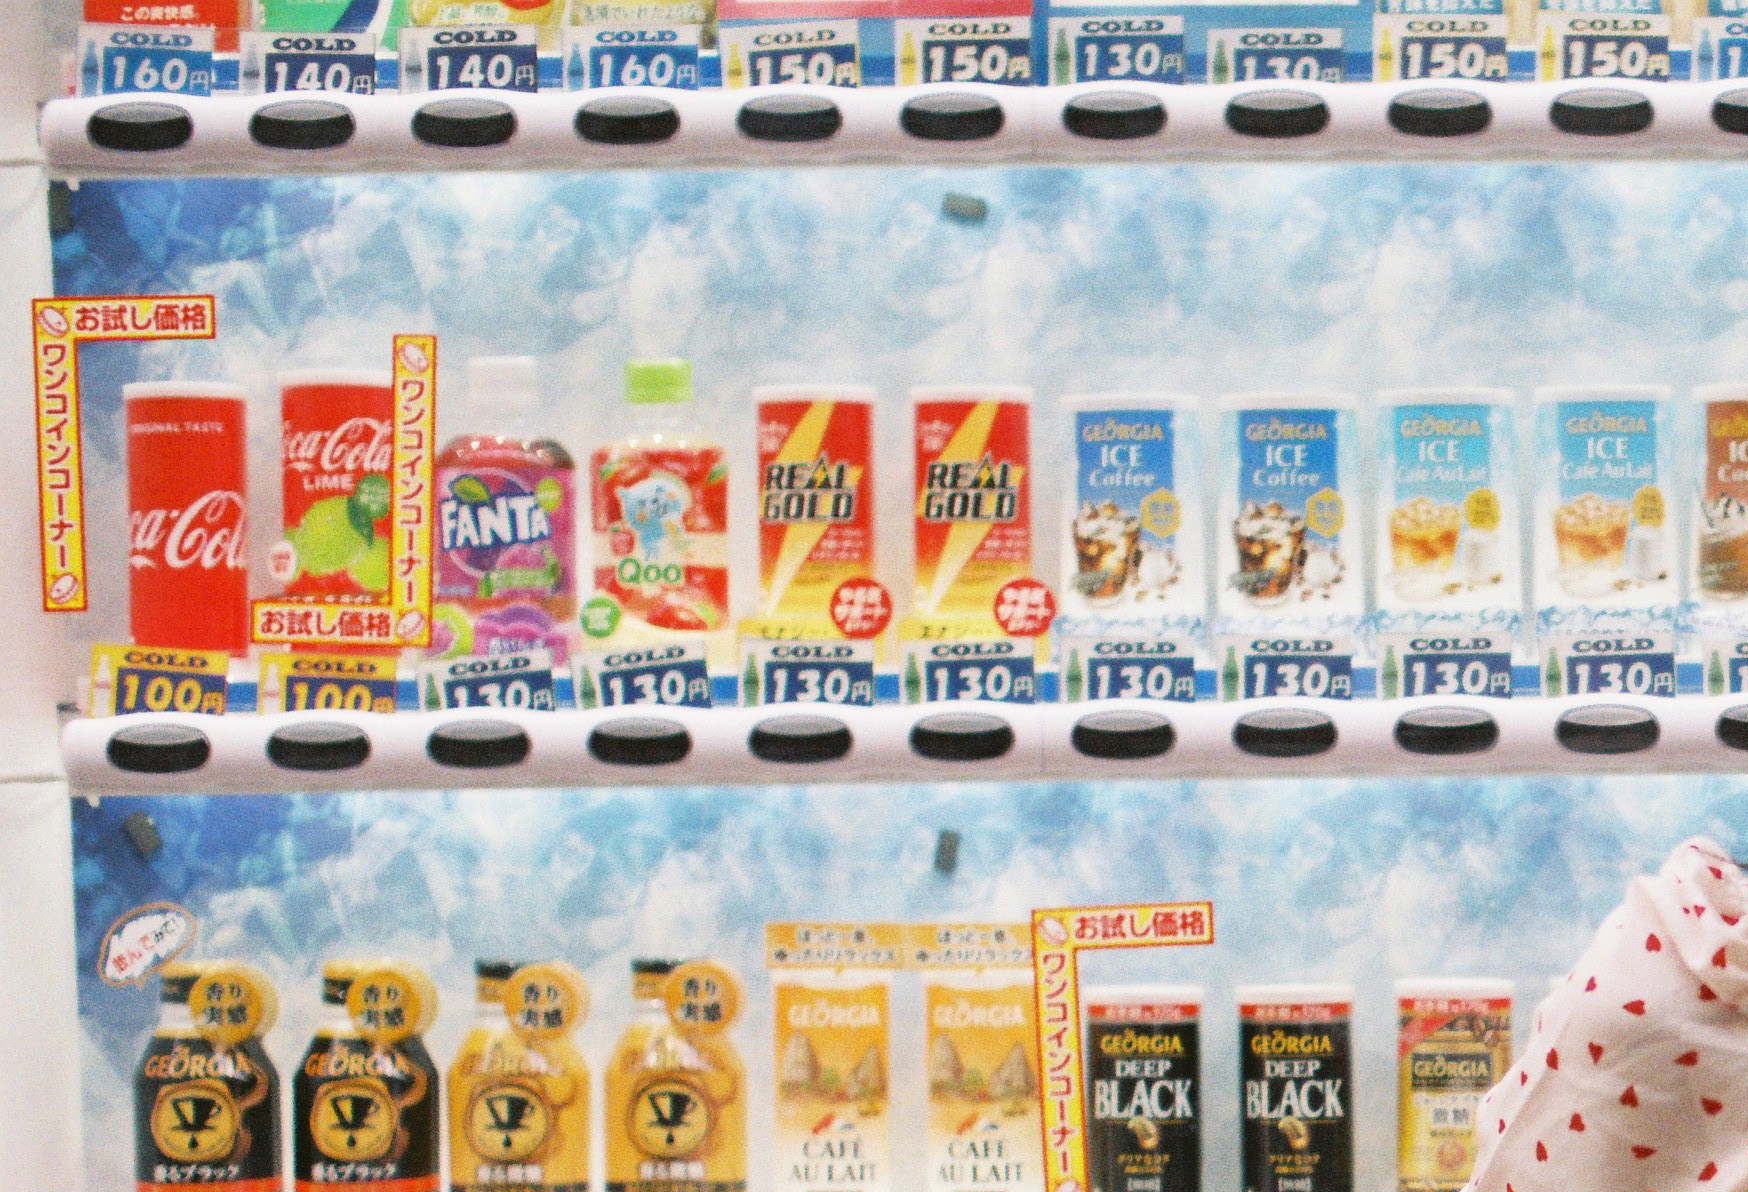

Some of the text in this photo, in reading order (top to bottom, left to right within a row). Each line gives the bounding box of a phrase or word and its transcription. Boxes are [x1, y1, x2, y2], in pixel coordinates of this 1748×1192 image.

[434, 31, 517, 44] COLD
[595, 30, 677, 43] COLD
[754, 28, 836, 46] COLD
[928, 22, 1010, 36] COLD
[1081, 20, 1164, 33] COLD
[1406, 19, 1488, 33] COLD
[1568, 19, 1651, 32] COLD
[110, 32, 192, 47] COLD
[272, 37, 356, 51] COLD
[1241, 33, 1323, 46] COLD
[437, 55, 534, 88] 140円
[599, 54, 696, 86] 160円
[756, 52, 856, 86] 150円
[930, 45, 1030, 81] 150円
[1084, 43, 1181, 77] 130円
[1243, 57, 1339, 82] 130円
[1407, 43, 1508, 78] 150円
[1569, 41, 1668, 77] 150円
[113, 57, 209, 92] 160円
[276, 62, 371, 94] 140円
[74, 304, 206, 332] お試し価格
[42, 343, 74, 568] ワンコインコーナー
[1100, 444, 1143, 469] ICE
[1265, 443, 1308, 468] ICE
[1418, 440, 1461, 463] ICE
[1587, 437, 1630, 461] ICE
[303, 474, 355, 491] LIME
[764, 456, 851, 490] REAL
[925, 456, 1012, 490] REAL
[1088, 468, 1156, 489] Coffee
[1252, 467, 1320, 488] Coffee
[400, 379, 426, 604] ワンコインコーナー
[763, 490, 855, 520] GOLD
[924, 490, 1016, 520] GOLD
[441, 496, 550, 550] FANTA
[617, 558, 682, 584] Qoo
[260, 609, 391, 639] お試し価格
[603, 646, 685, 666] COLD
[771, 645, 854, 658] COLD
[931, 642, 1014, 657] COLD
[1094, 641, 1176, 655] COLD
[1251, 639, 1333, 653] COLD
[1410, 637, 1492, 651] COLD
[1572, 637, 1655, 653] COLD
[124, 652, 208, 668] COLD
[293, 661, 377, 675] COLD
[448, 656, 530, 676] COLD
[610, 669, 708, 703] 130円
[774, 668, 872, 703] 130円
[935, 666, 1034, 700] 130円
[1096, 666, 1194, 699] 130円
[1253, 663, 1350, 698] 130円
[1412, 660, 1510, 695] 130円
[1575, 662, 1675, 694] 130円
[124, 674, 224, 715] 100円
[295, 681, 394, 713] 100円
[455, 680, 554, 711] 130円
[1075, 910, 1206, 940] お試し価格
[1100, 1034, 1183, 1056] GEORGIA
[1250, 1034, 1333, 1056] GEORGIA
[144, 1047, 253, 1079] GEORGIA
[304, 1046, 411, 1079] GEORGIA
[1042, 953, 1076, 1175] ワンコインコーナー
[1115, 1060, 1172, 1079] DEEP
[1265, 1060, 1322, 1079] DEEP
[1412, 1057, 1489, 1081] GEORGIA
[1095, 1080, 1193, 1120] BLACK
[1245, 1080, 1343, 1120] BLACK
